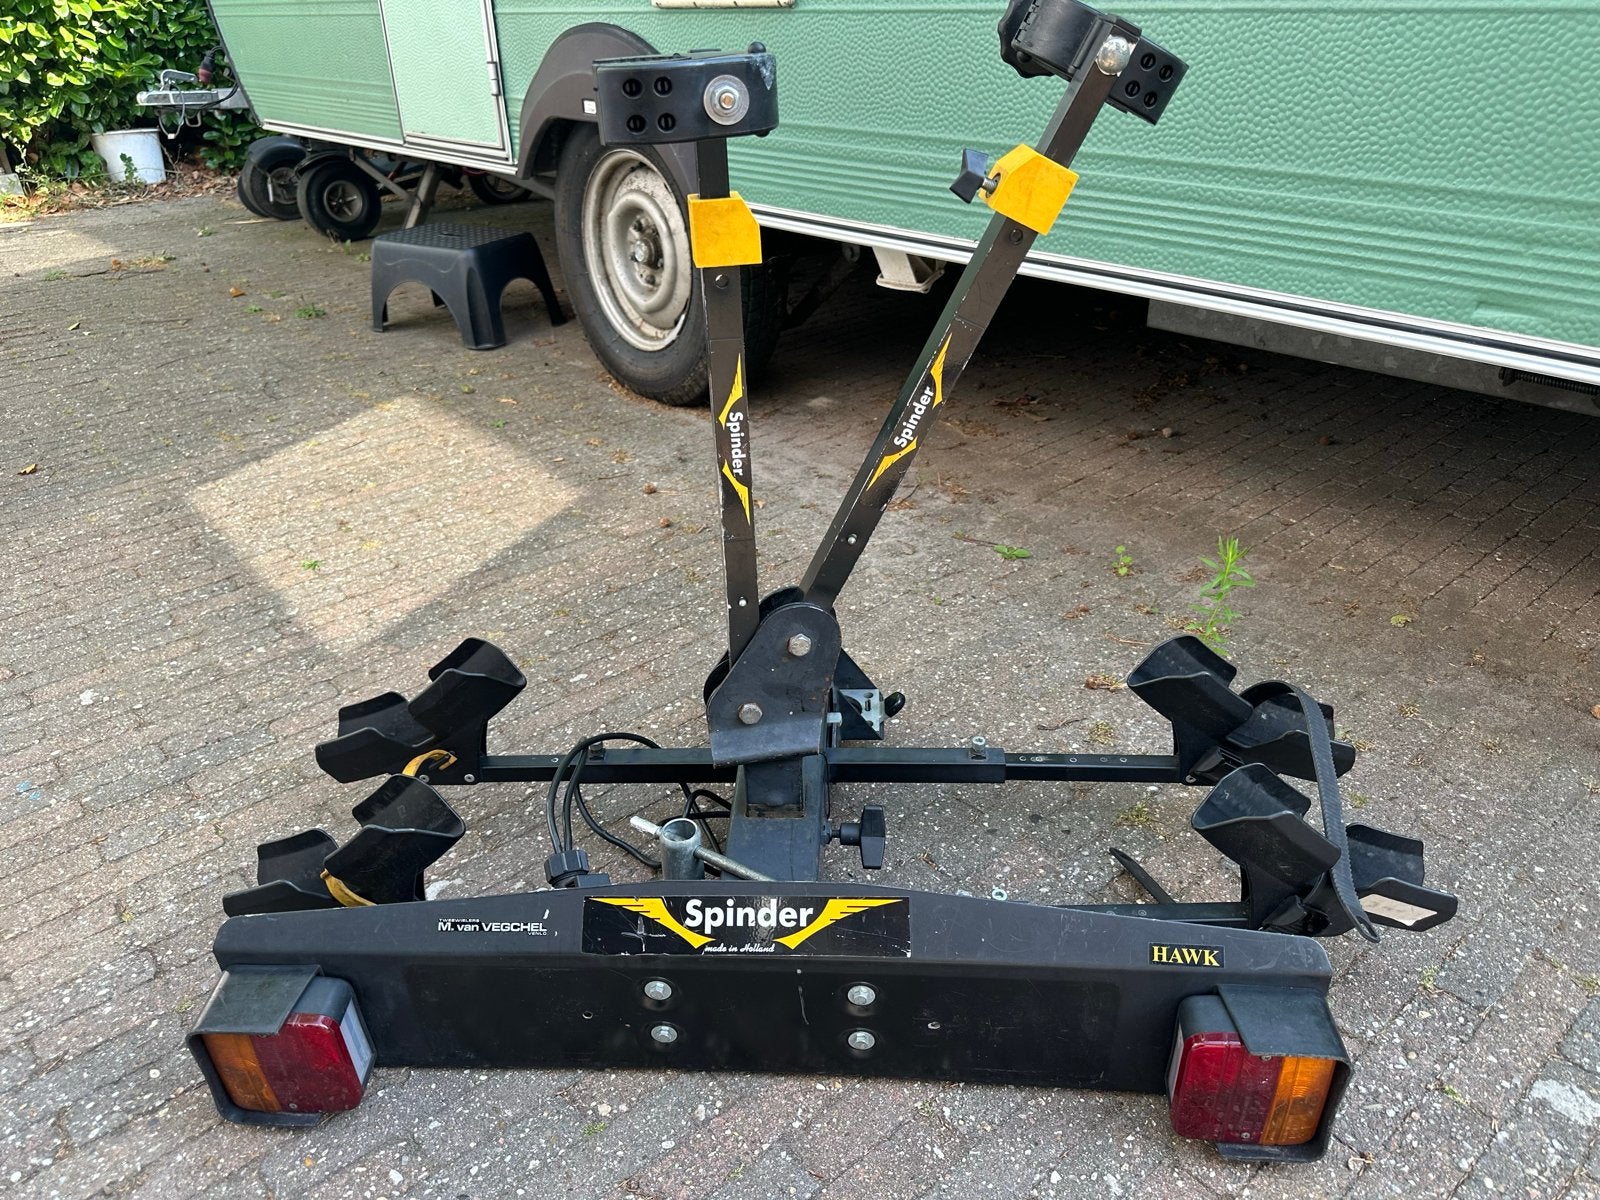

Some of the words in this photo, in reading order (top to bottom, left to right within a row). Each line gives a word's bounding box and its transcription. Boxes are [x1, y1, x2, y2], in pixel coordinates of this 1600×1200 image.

[893, 386, 934, 448] Spinder
[726, 412, 747, 476] Spinder
[438, 922, 455, 931] M.
[482, 922, 548, 932] VEGCHEL
[684, 898, 814, 934] Spinder
[703, 943, 727, 953] made
[728, 943, 738, 952] in
[739, 943, 775, 952] Holland
[1152, 945, 1220, 967] HAWK
